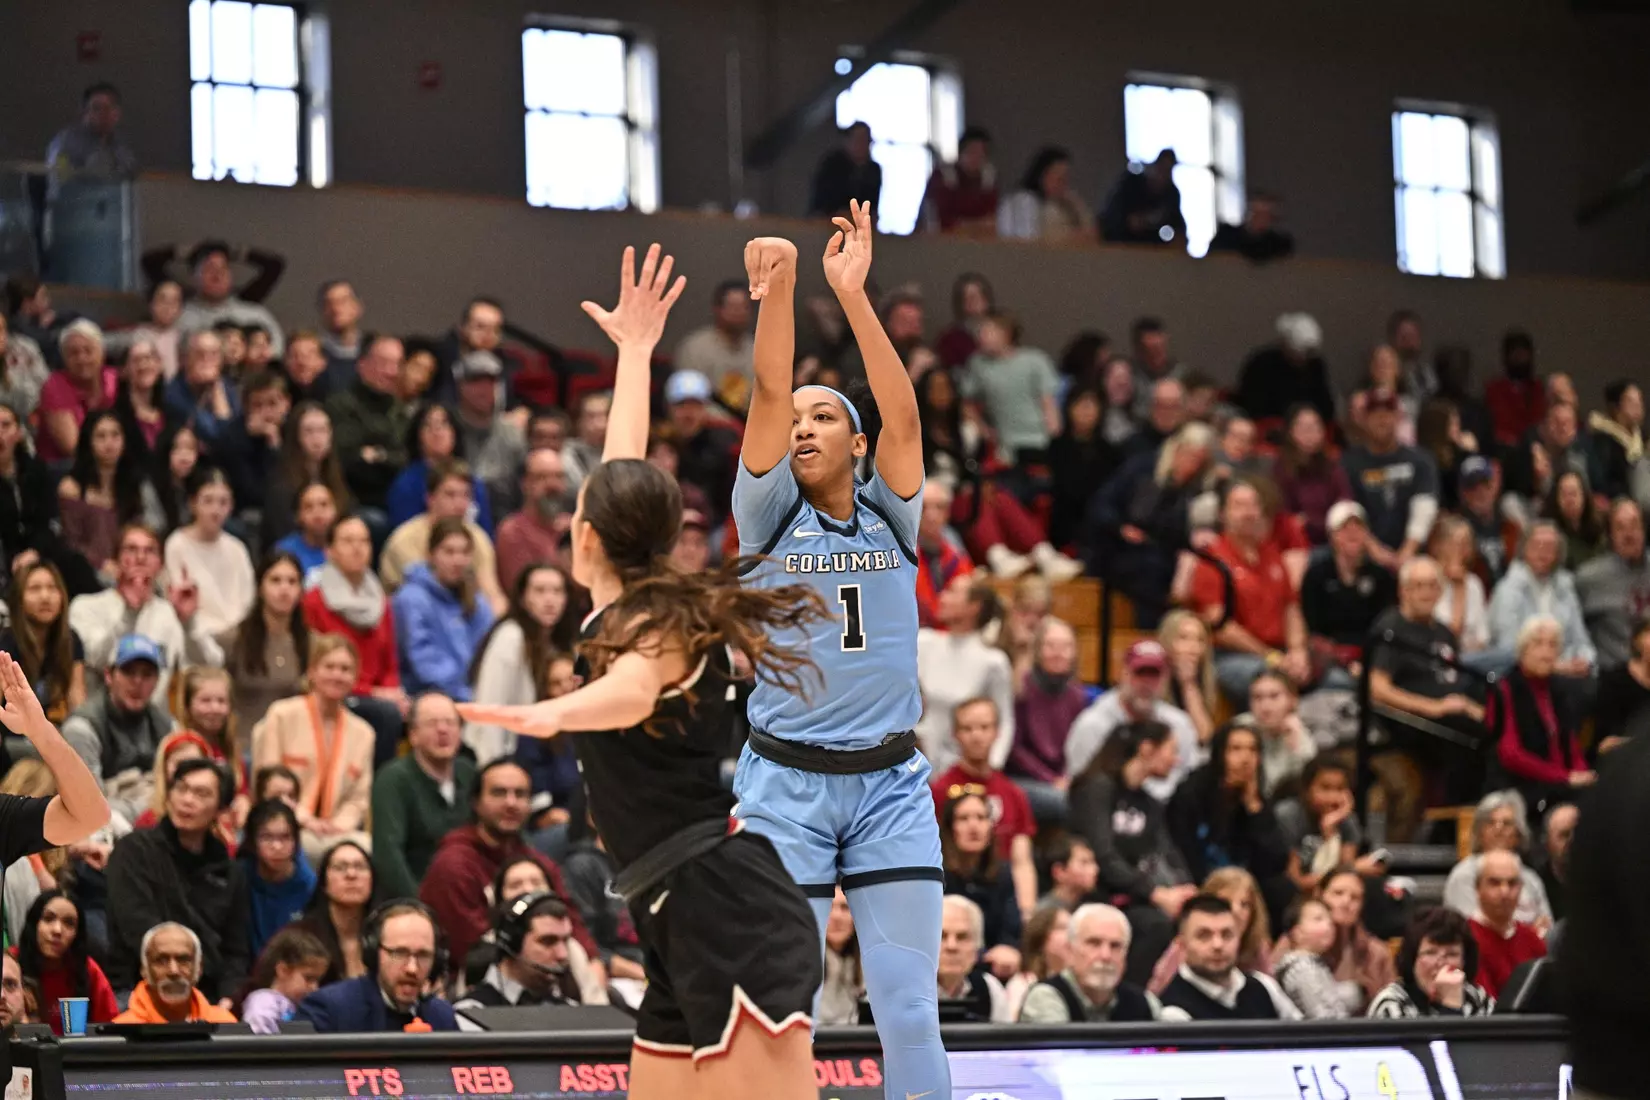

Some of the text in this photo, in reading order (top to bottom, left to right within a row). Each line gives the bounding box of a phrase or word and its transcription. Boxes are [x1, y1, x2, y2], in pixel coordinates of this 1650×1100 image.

[838, 584, 866, 652] 1
[344, 1067, 404, 1095] PTS
[451, 1066, 514, 1094] REB
[559, 1064, 629, 1092] ASST
[814, 1058, 883, 1088] OULS
